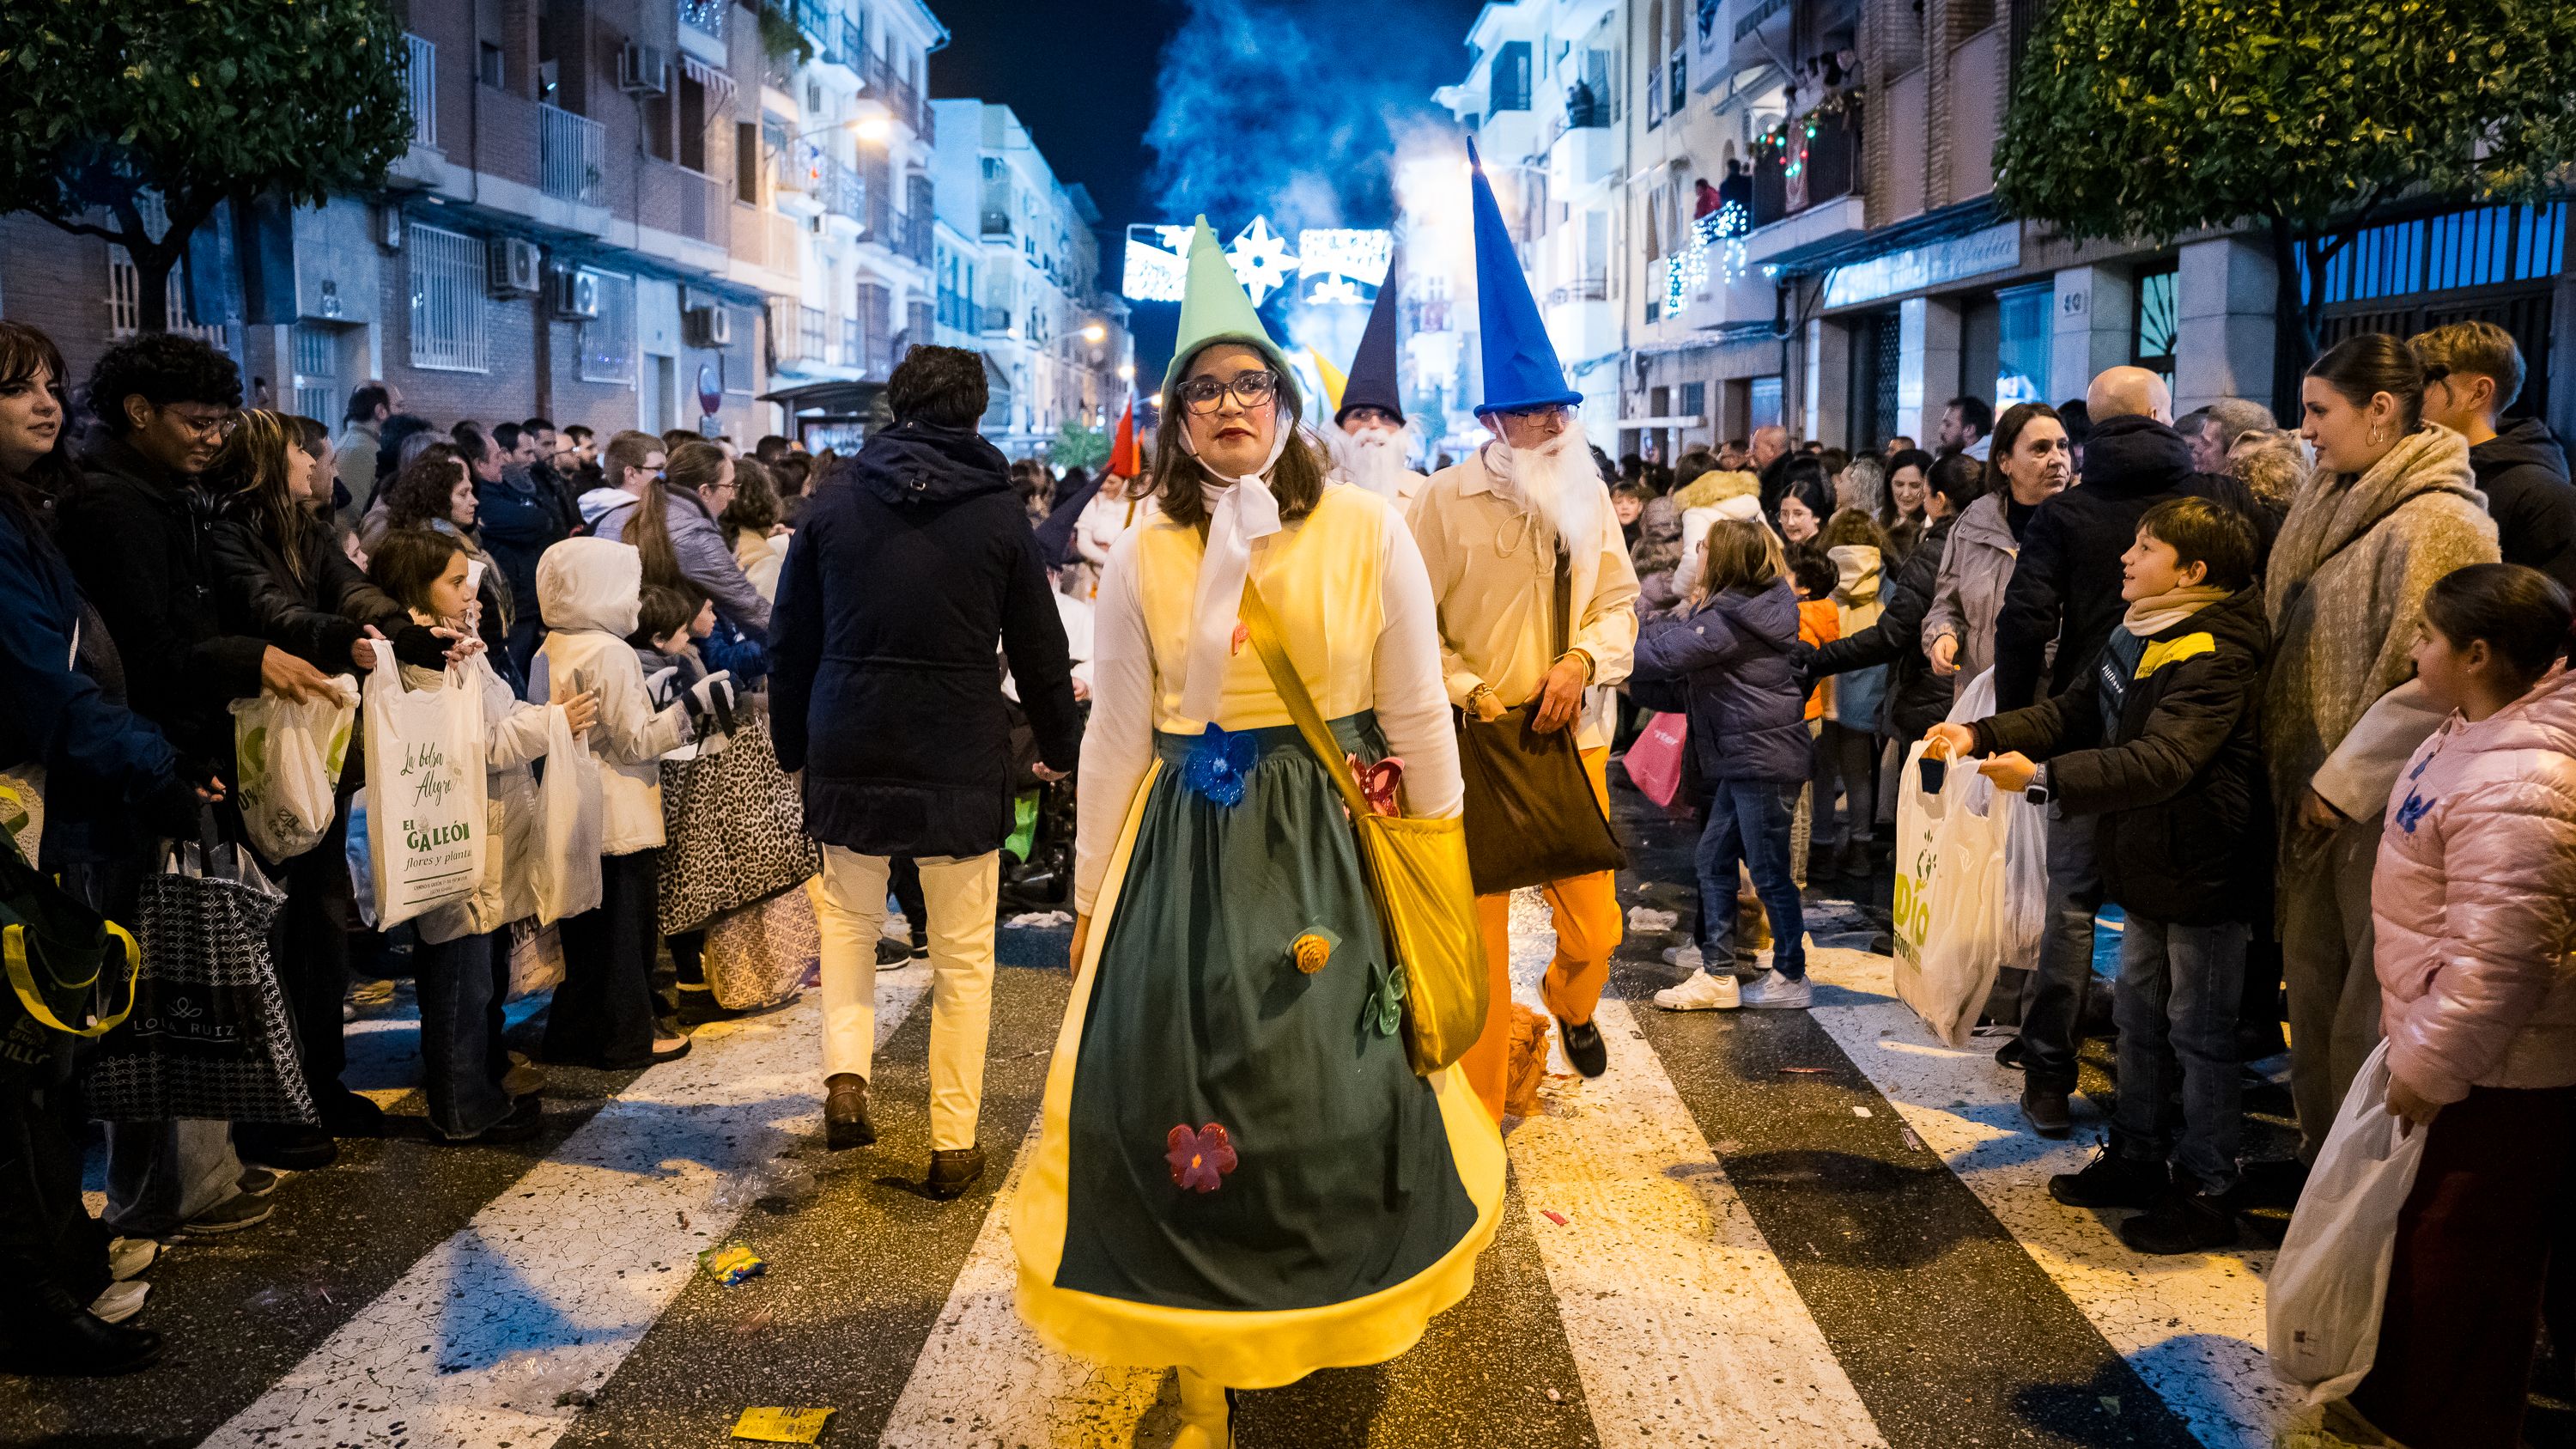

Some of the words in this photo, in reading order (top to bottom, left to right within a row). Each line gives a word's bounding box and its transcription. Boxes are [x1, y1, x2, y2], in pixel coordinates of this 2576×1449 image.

[400, 742, 415, 776] La
[419, 741, 444, 768] bolsa
[412, 770, 454, 807] Alegre
[404, 857, 433, 872] flores
[434, 855, 442, 866] y
[134, 1017, 177, 1032] LOLA
[191, 1023, 234, 1037] RUIZ
